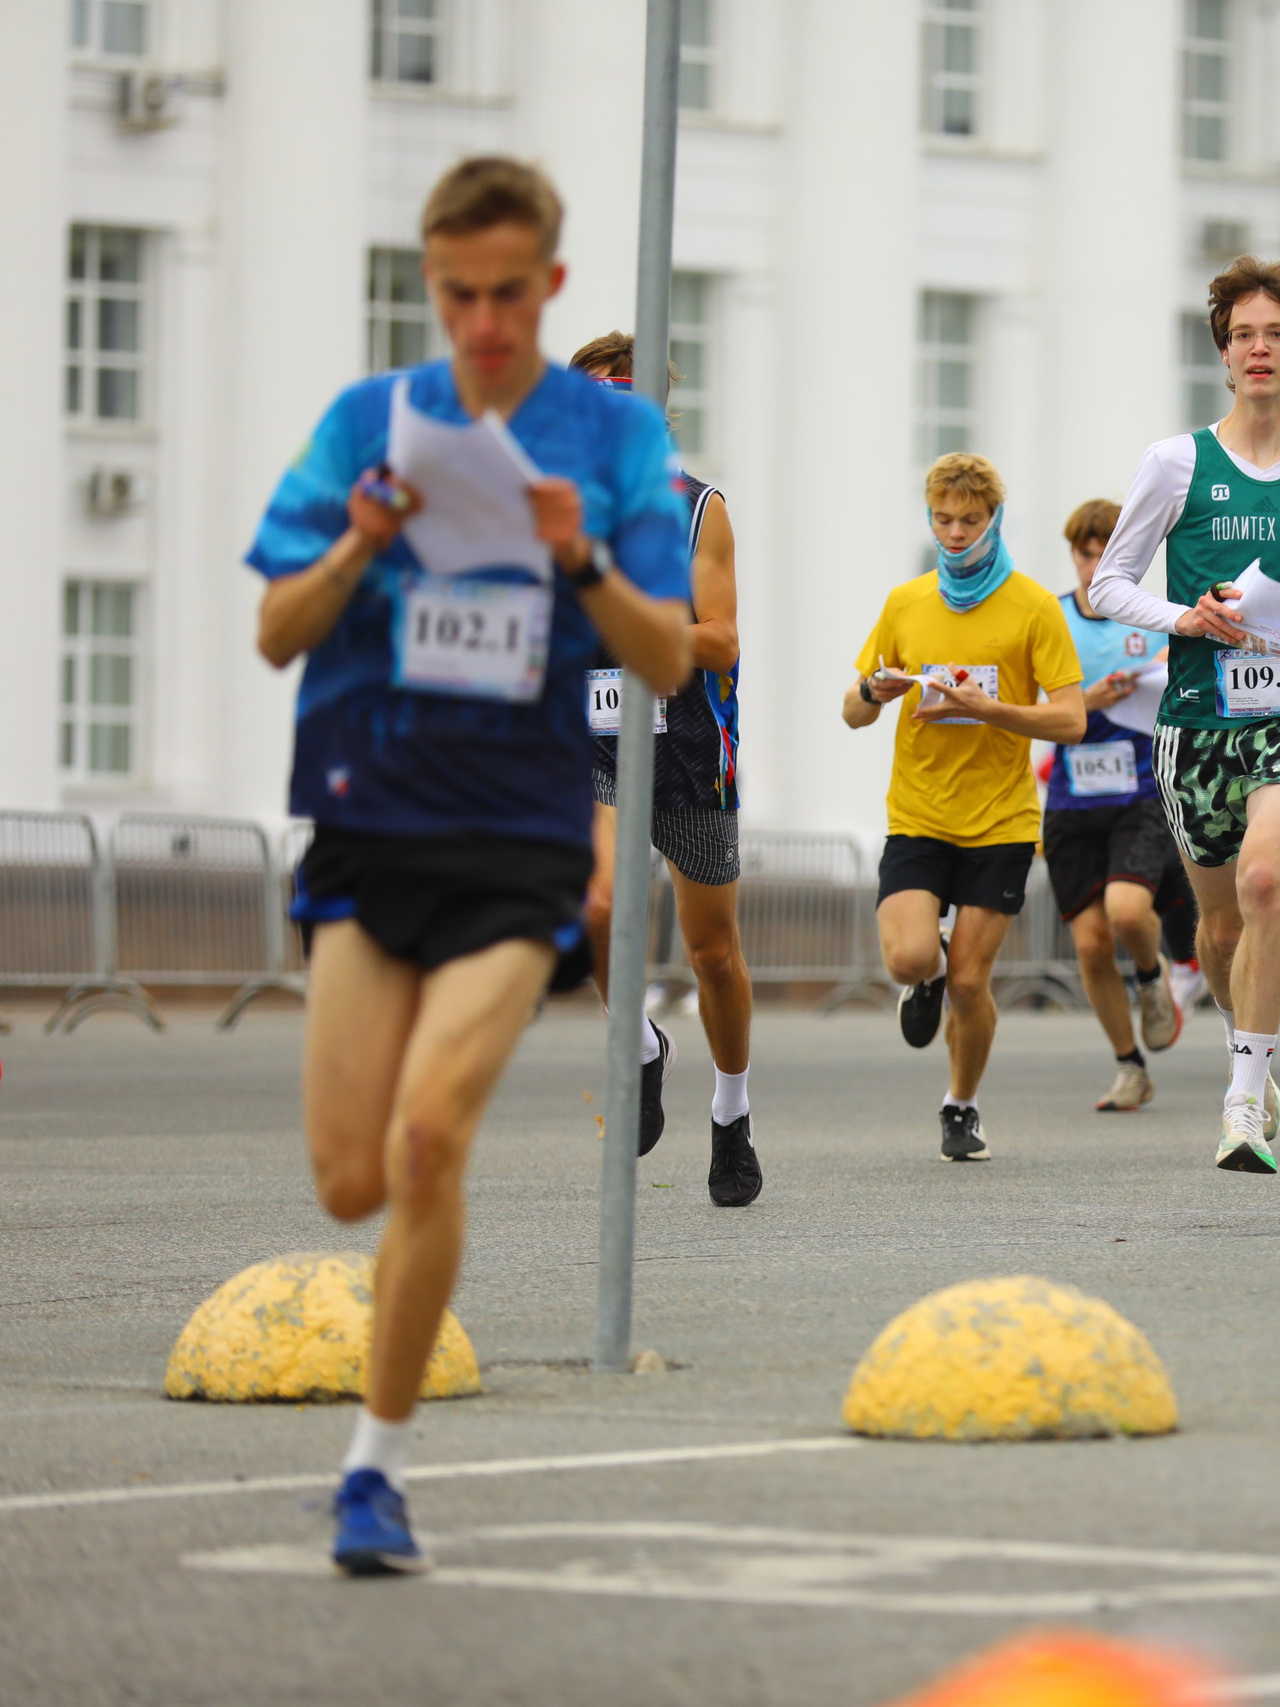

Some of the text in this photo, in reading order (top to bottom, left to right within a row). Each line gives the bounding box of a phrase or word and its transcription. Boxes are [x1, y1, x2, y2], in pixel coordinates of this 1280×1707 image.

[1212, 516, 1276, 541] ПОЛИТЕХ
[417, 608, 519, 653] 102.1
[1075, 757, 1121, 777] 105.1
